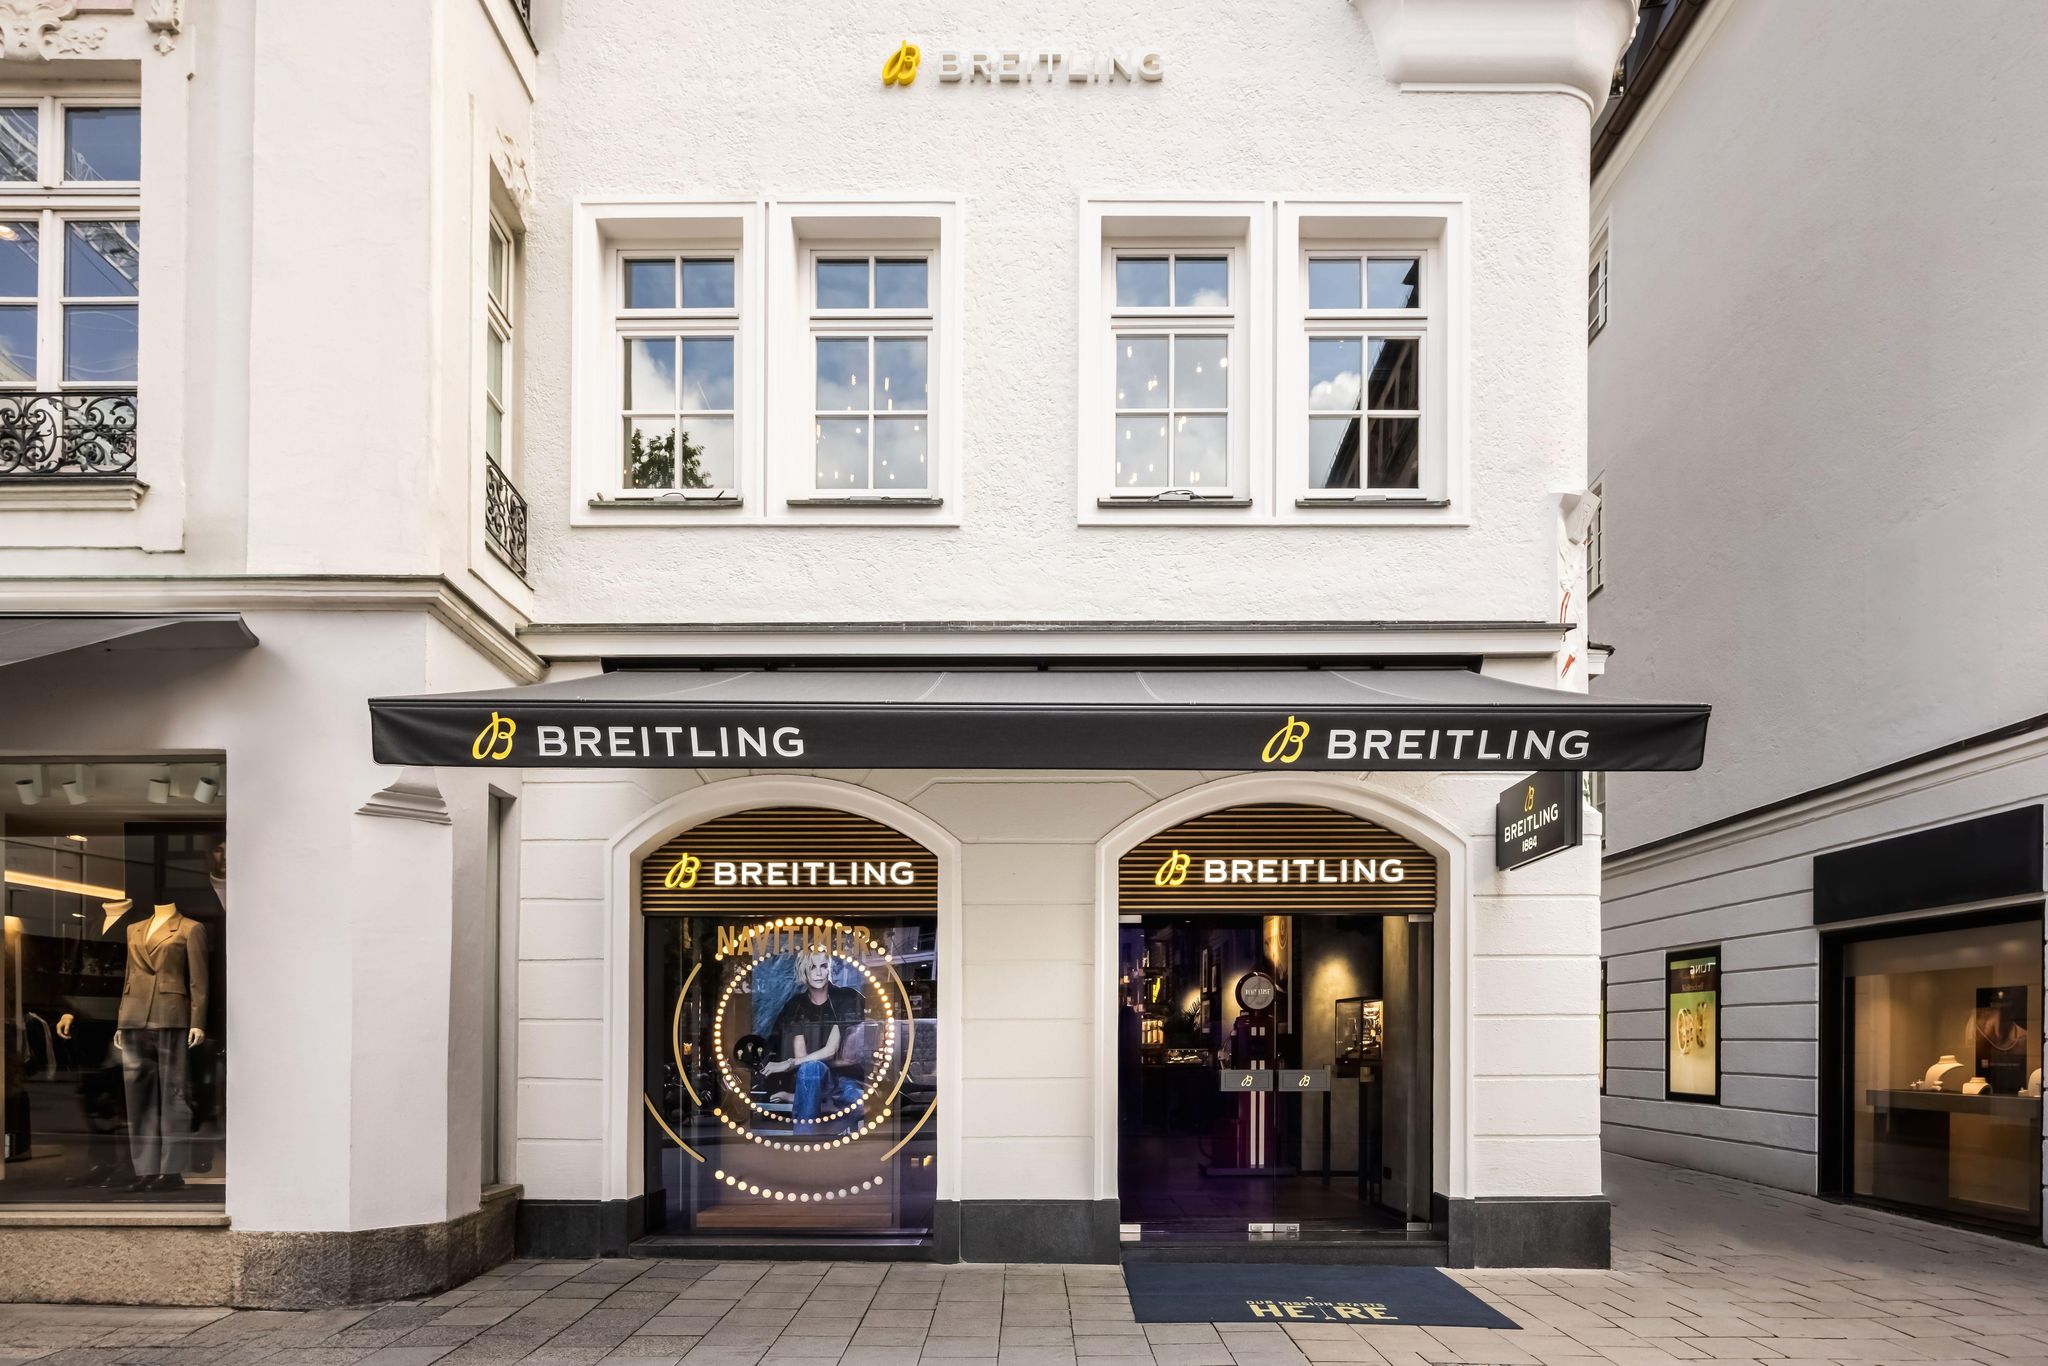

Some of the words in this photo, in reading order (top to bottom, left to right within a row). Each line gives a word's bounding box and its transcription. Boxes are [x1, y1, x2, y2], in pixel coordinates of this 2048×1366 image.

[938, 51, 1164, 83] BREITLING
[537, 725, 804, 757] BREITLING
[1327, 729, 1590, 760] BREITLING
[1504, 803, 1559, 843] BREITLING
[1522, 835, 1538, 853] 1884
[713, 861, 915, 886] BREITLING
[1203, 858, 1405, 884] BREITLING
[717, 925, 872, 956] NAVITIMER
